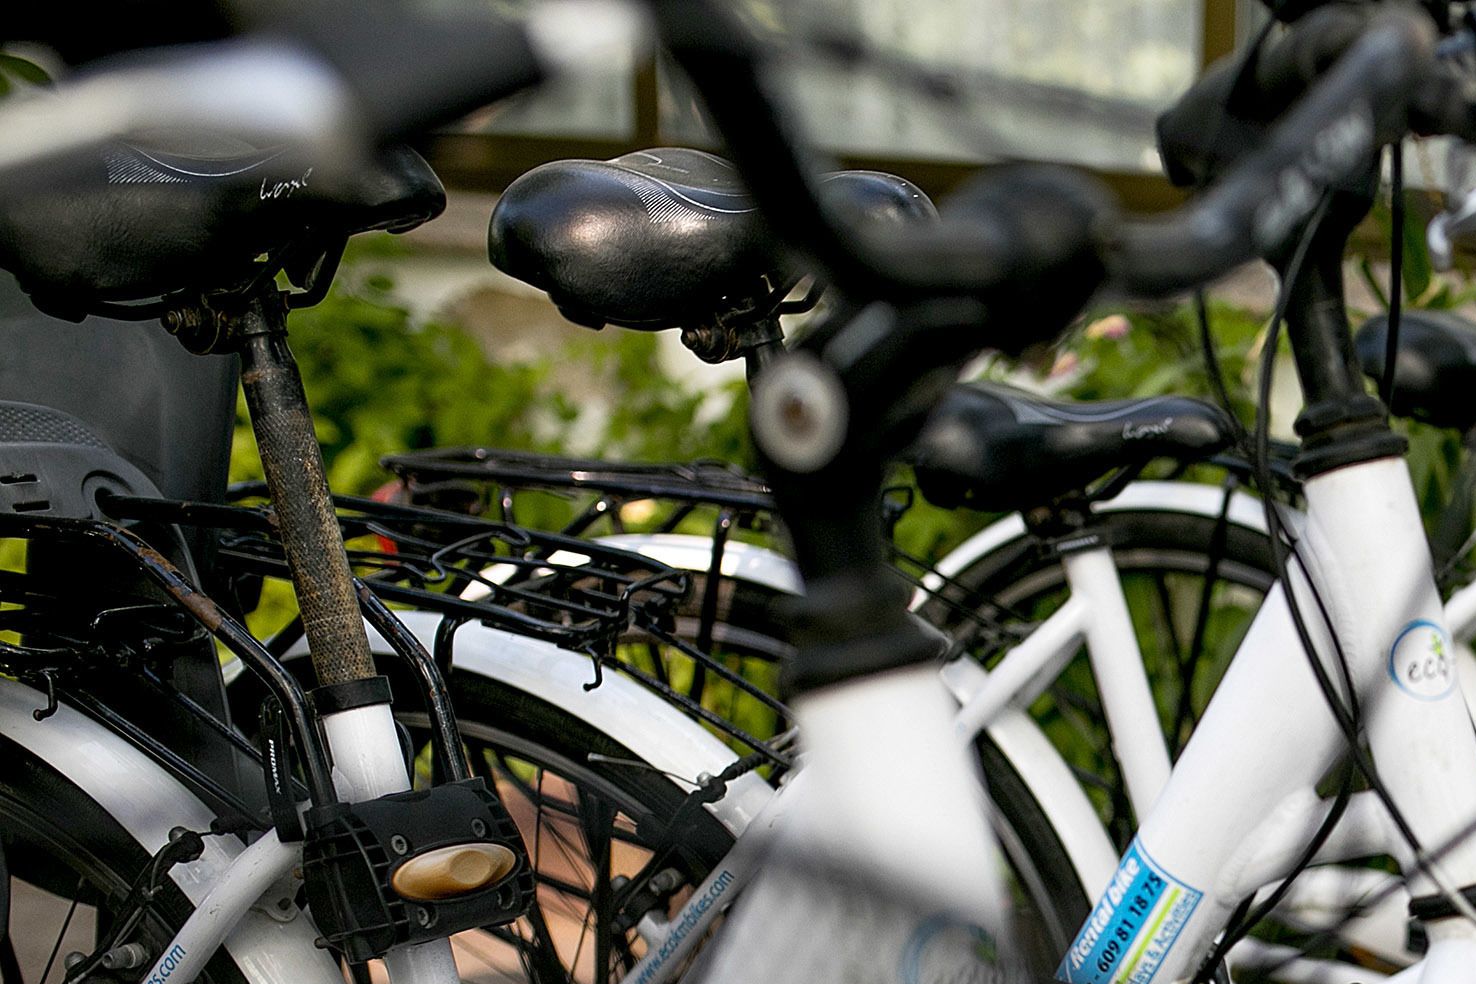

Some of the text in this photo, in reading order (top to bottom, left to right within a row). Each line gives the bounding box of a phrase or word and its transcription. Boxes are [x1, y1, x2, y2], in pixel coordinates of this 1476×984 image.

[268, 738, 282, 796] PROMAX
[1069, 898, 1115, 970] Rental
[1108, 856, 1140, 910] bike
[1097, 939, 1120, 973] 609
[1115, 918, 1135, 941] 81
[1128, 895, 1149, 917] 18
[1142, 872, 1162, 896] 75
